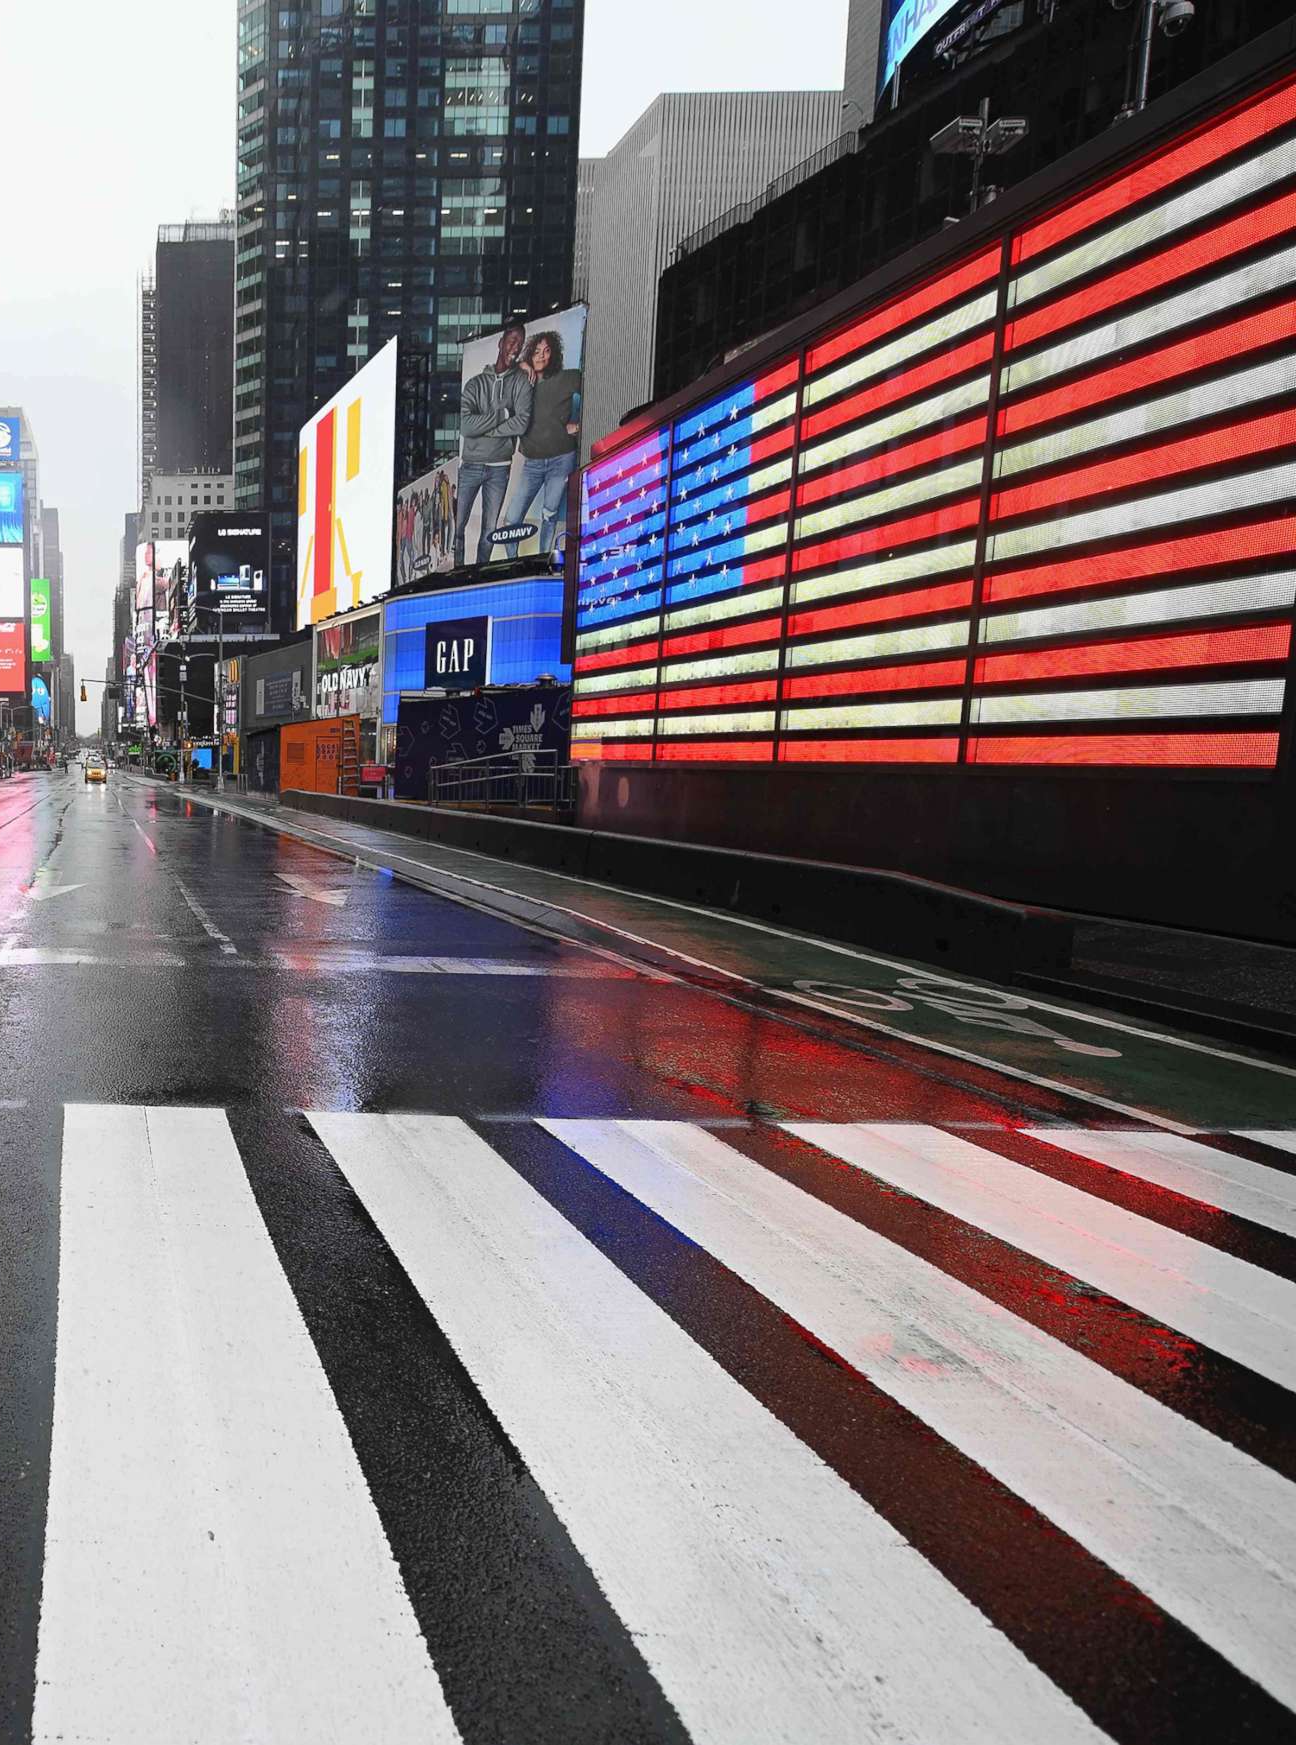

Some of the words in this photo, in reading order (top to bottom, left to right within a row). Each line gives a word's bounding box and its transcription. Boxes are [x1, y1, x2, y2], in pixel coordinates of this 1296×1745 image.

[491, 531, 508, 541] OLD
[508, 526, 533, 539] NAVY
[436, 639, 474, 673] GAP
[321, 672, 339, 693] OLD
[515, 733, 544, 742] SQUARE
